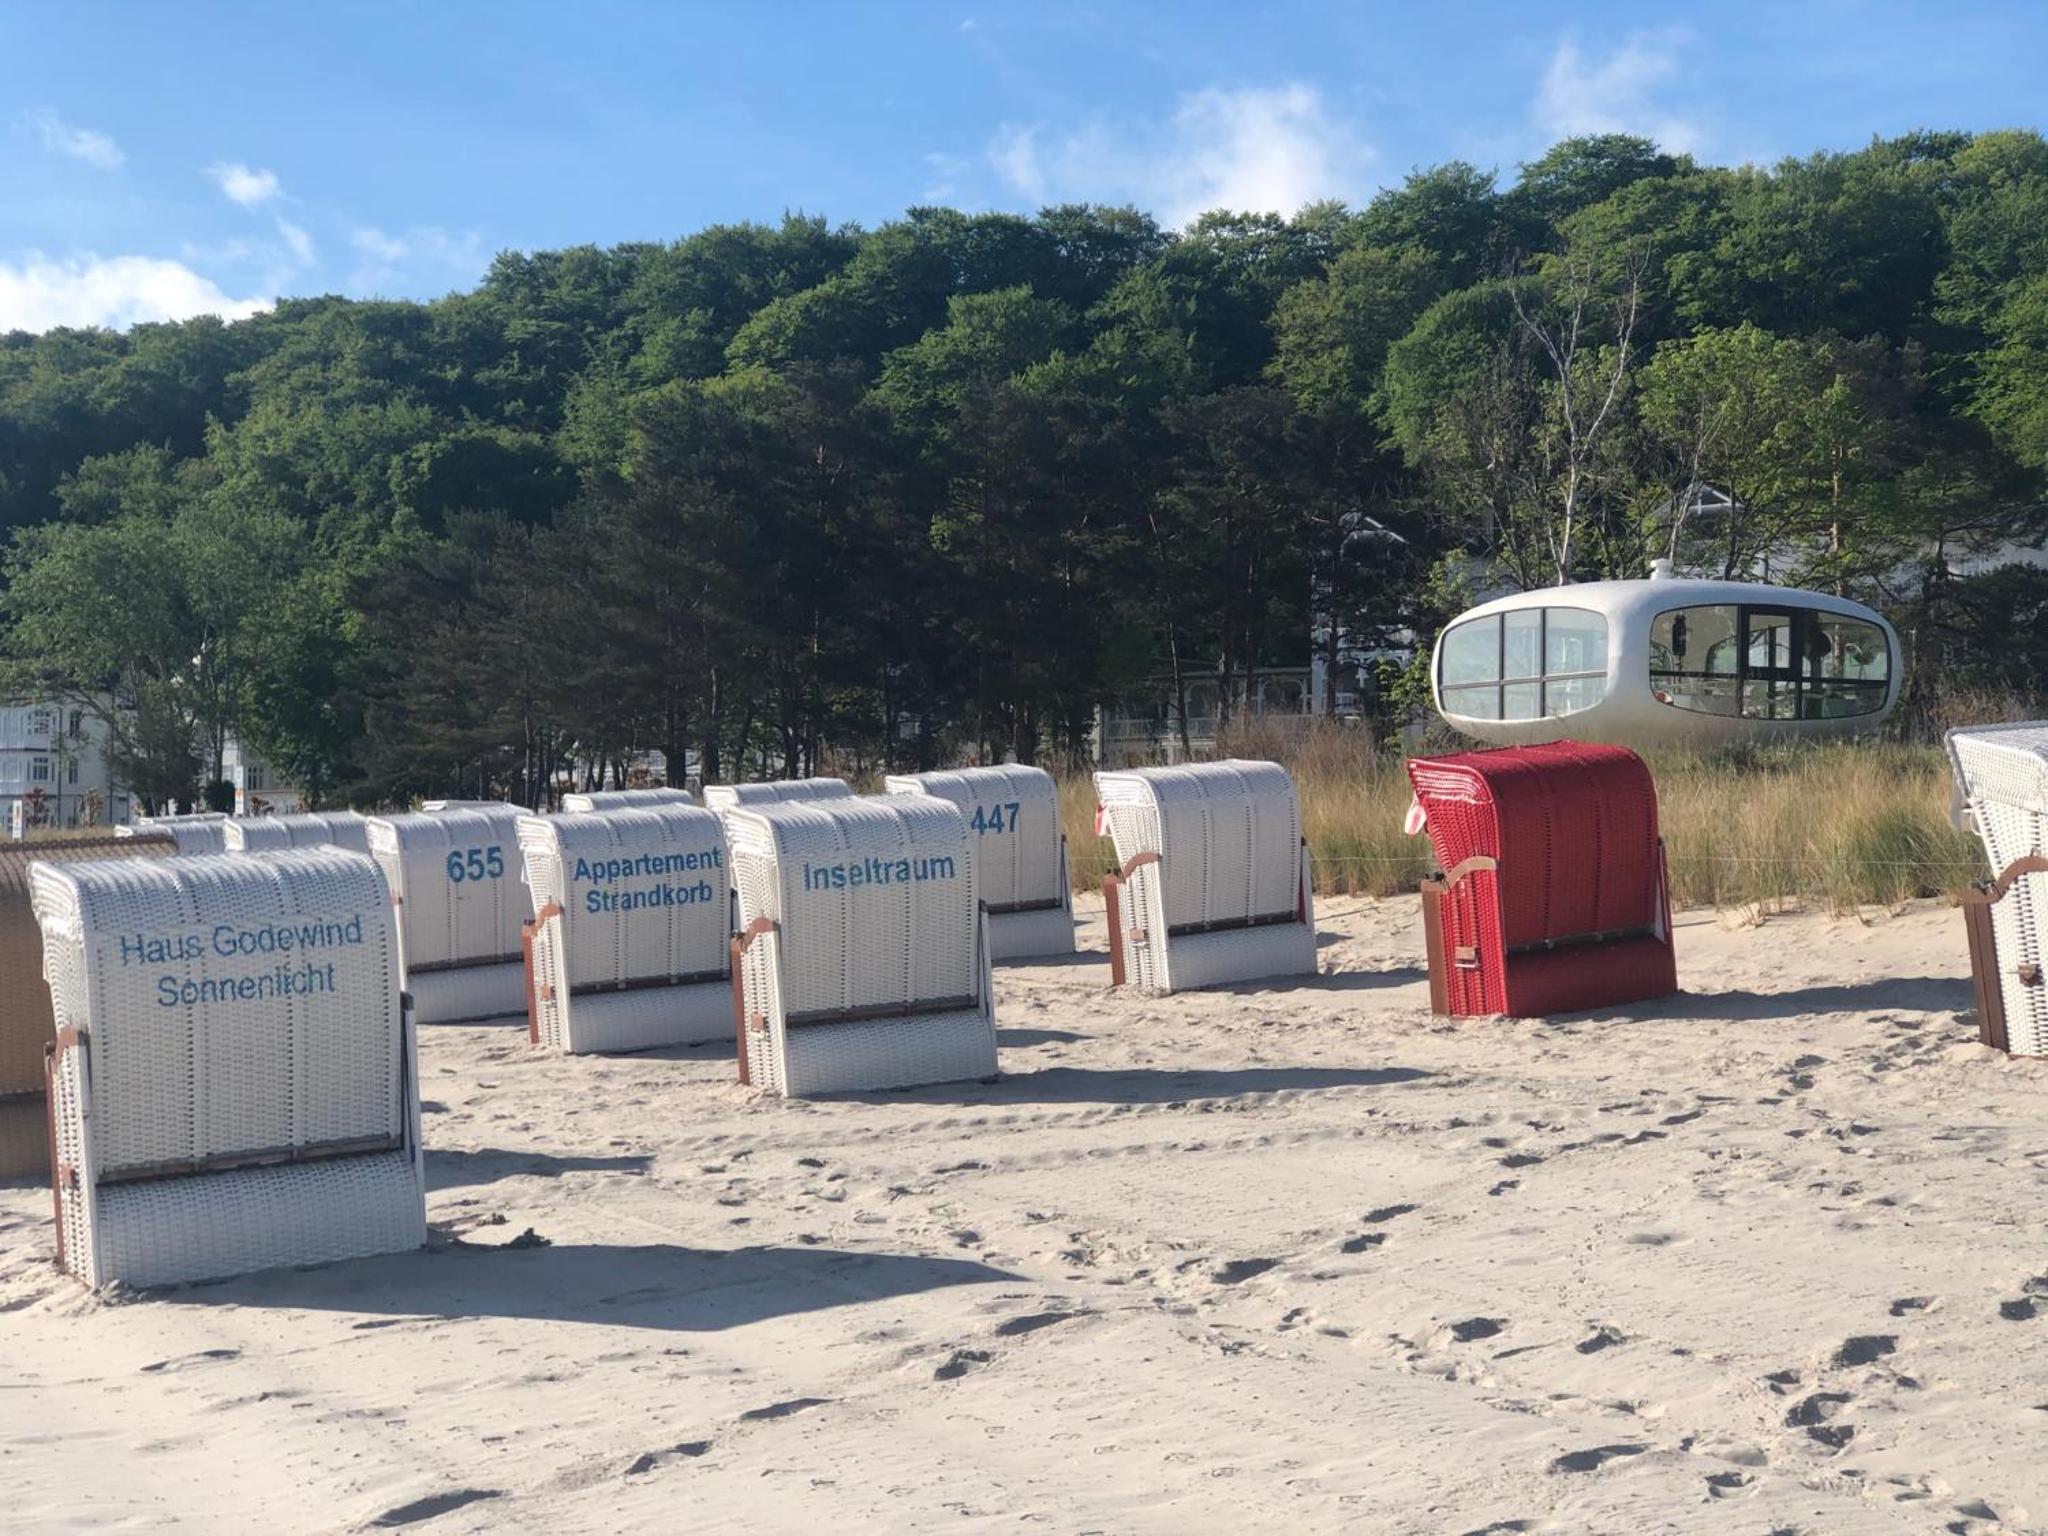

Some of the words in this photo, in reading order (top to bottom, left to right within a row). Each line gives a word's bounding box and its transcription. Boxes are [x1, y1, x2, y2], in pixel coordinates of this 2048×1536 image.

[971, 802, 1019, 835] 447
[447, 846, 504, 882] 655
[573, 846, 722, 885] Appartement
[803, 856, 955, 891] Inseltraum
[586, 880, 712, 913] Strandkorb
[120, 933, 204, 966] Haus
[213, 914, 362, 957] Godewind
[157, 962, 335, 1006] Sonnenlicht
